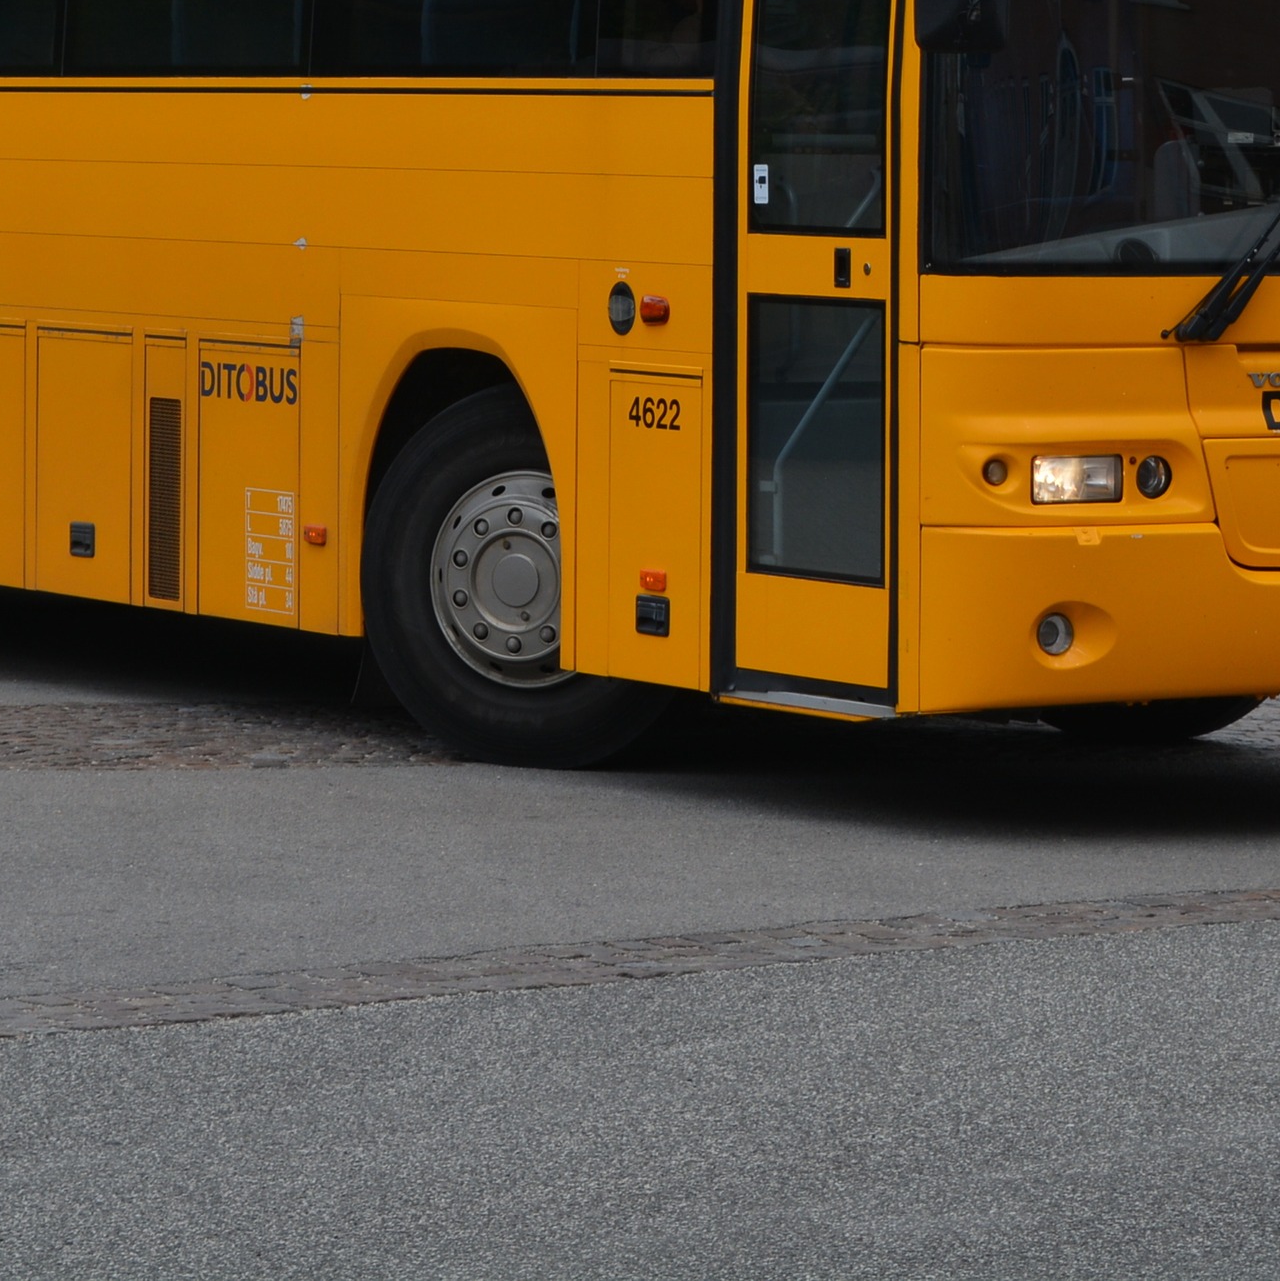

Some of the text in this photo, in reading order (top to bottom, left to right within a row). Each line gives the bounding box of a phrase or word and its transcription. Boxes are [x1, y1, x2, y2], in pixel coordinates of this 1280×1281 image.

[201, 361, 298, 405] DITOBUS
[629, 396, 681, 431] 4622
[246, 491, 251, 509] T
[247, 513, 252, 532] L
